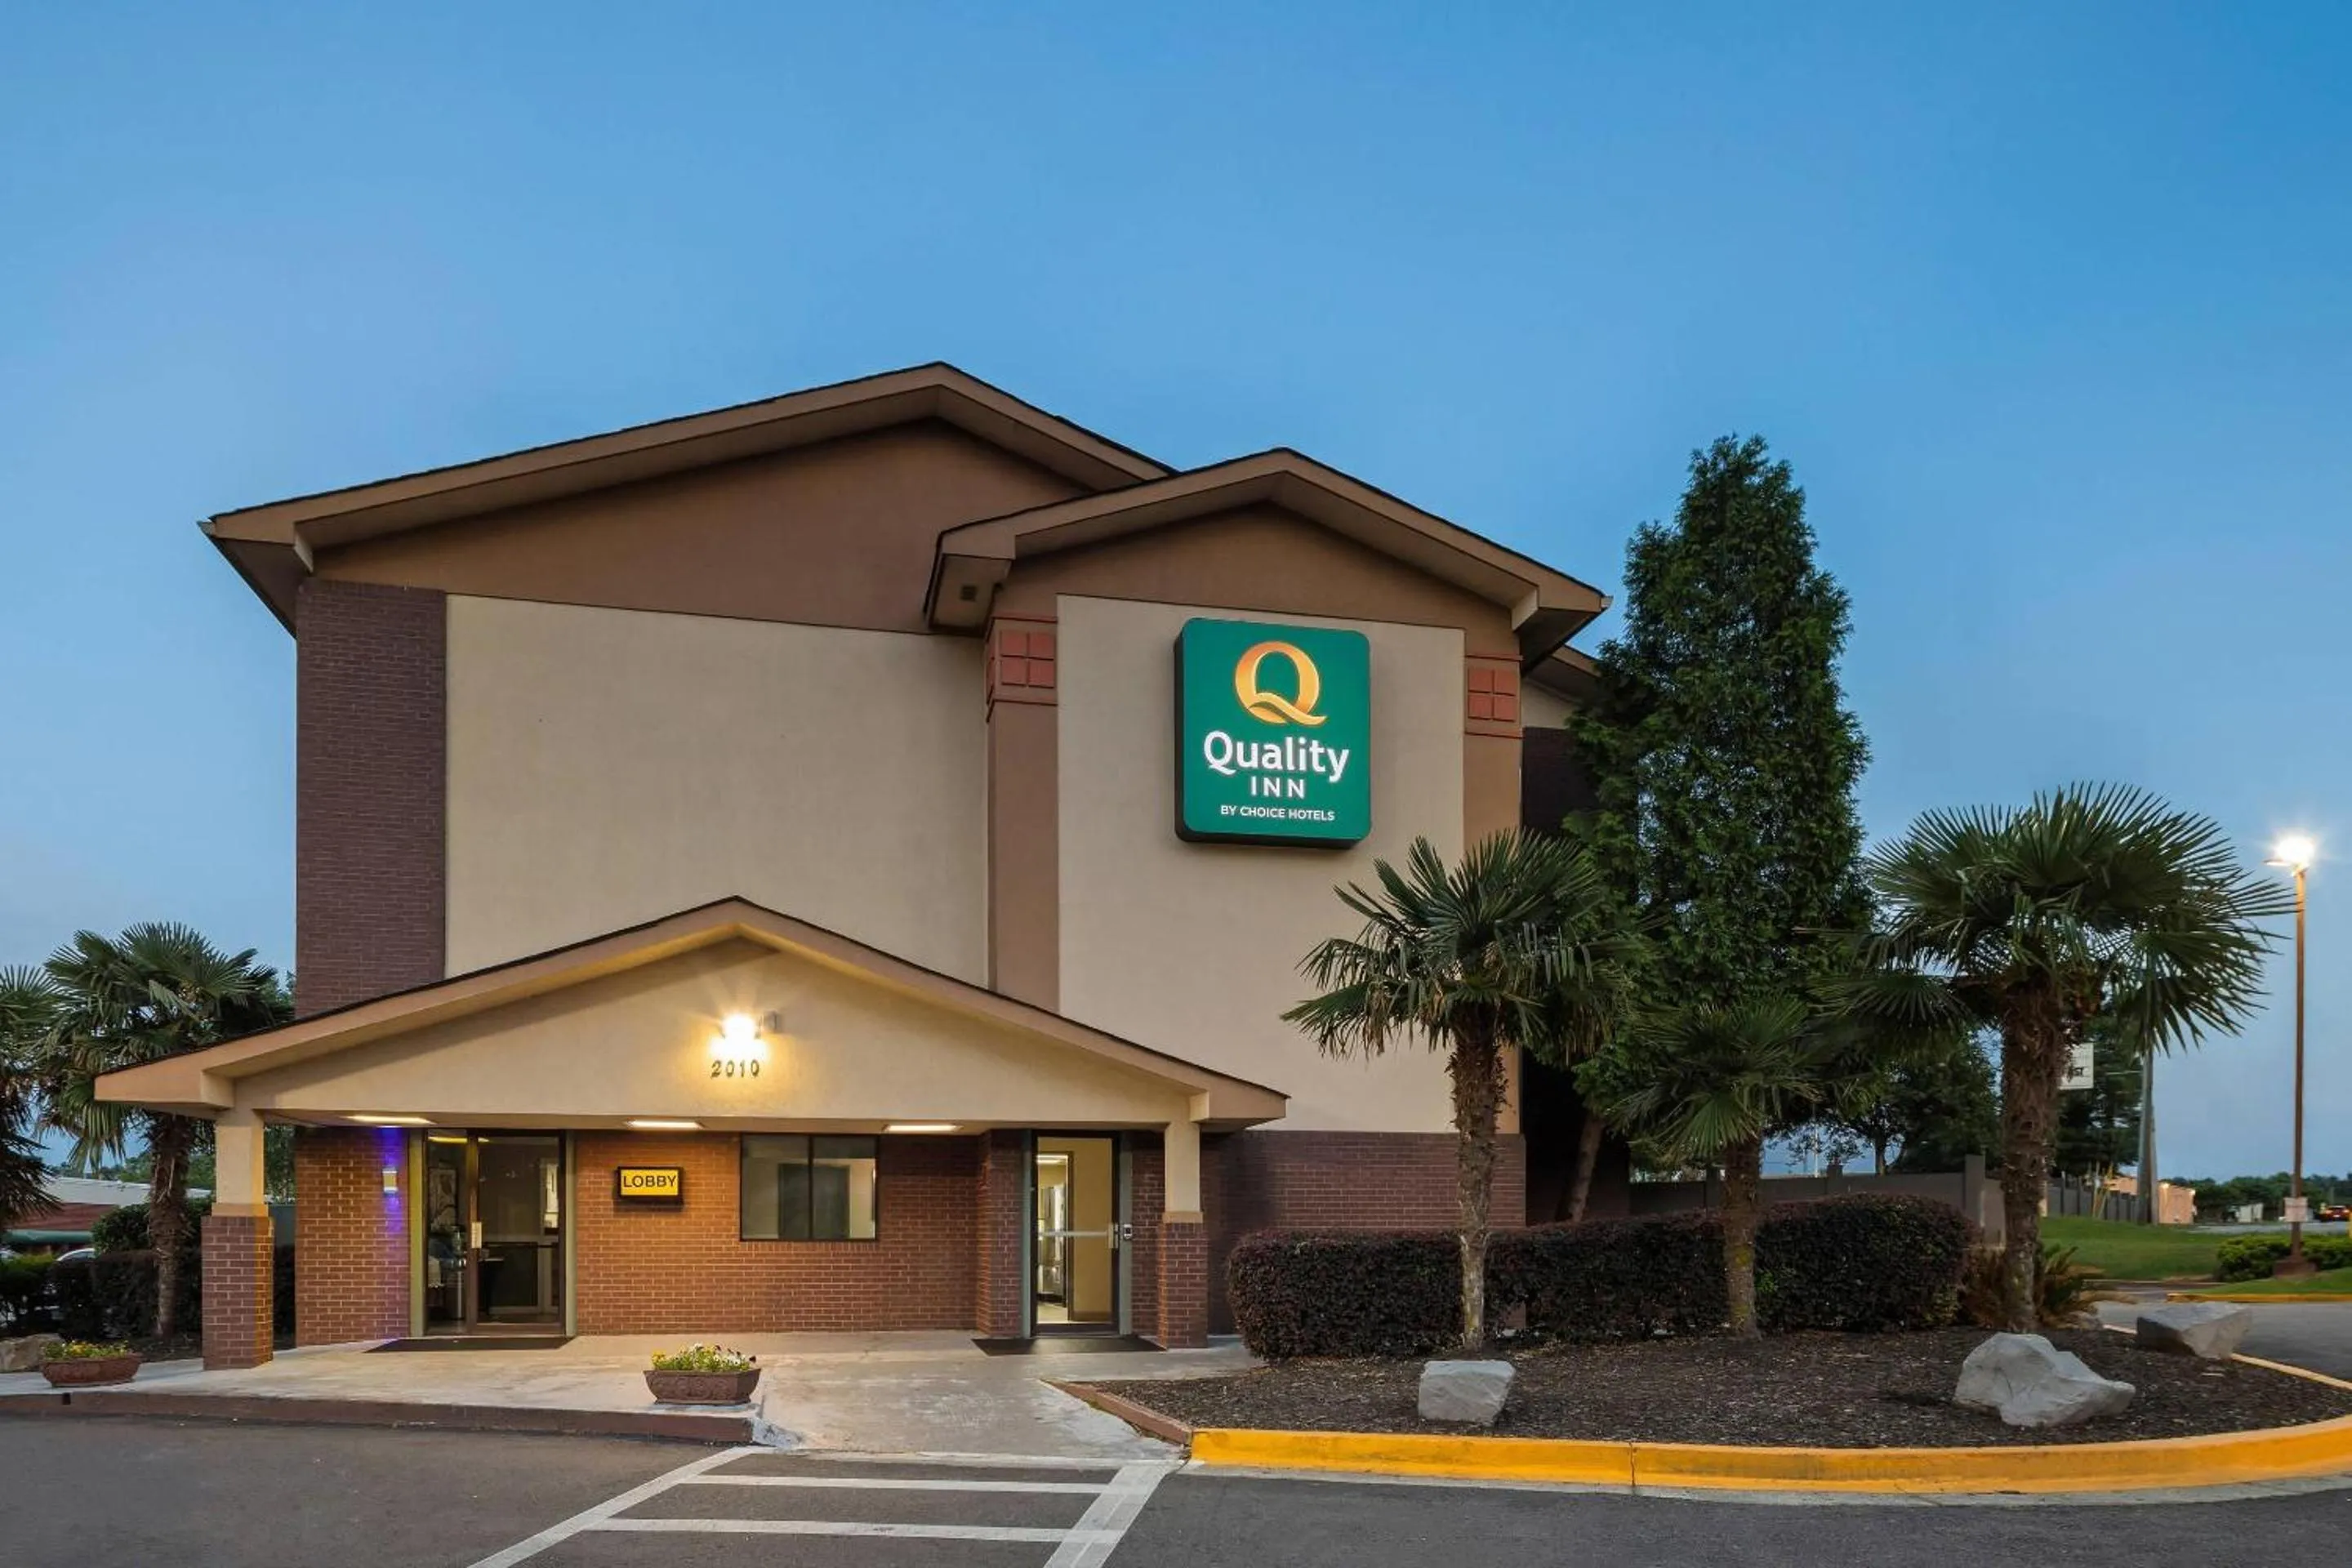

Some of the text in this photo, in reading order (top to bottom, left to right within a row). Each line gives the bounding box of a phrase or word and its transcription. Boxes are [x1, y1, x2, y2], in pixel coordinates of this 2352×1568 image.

[1234, 640, 1328, 726] Q
[1203, 730, 1350, 783] Quality
[1250, 776, 1305, 800] INN
[1220, 805, 1335, 822] BY CHOICE HOTELS
[710, 1059, 760, 1078] 2010
[623, 1175, 676, 1187] LOBBY
